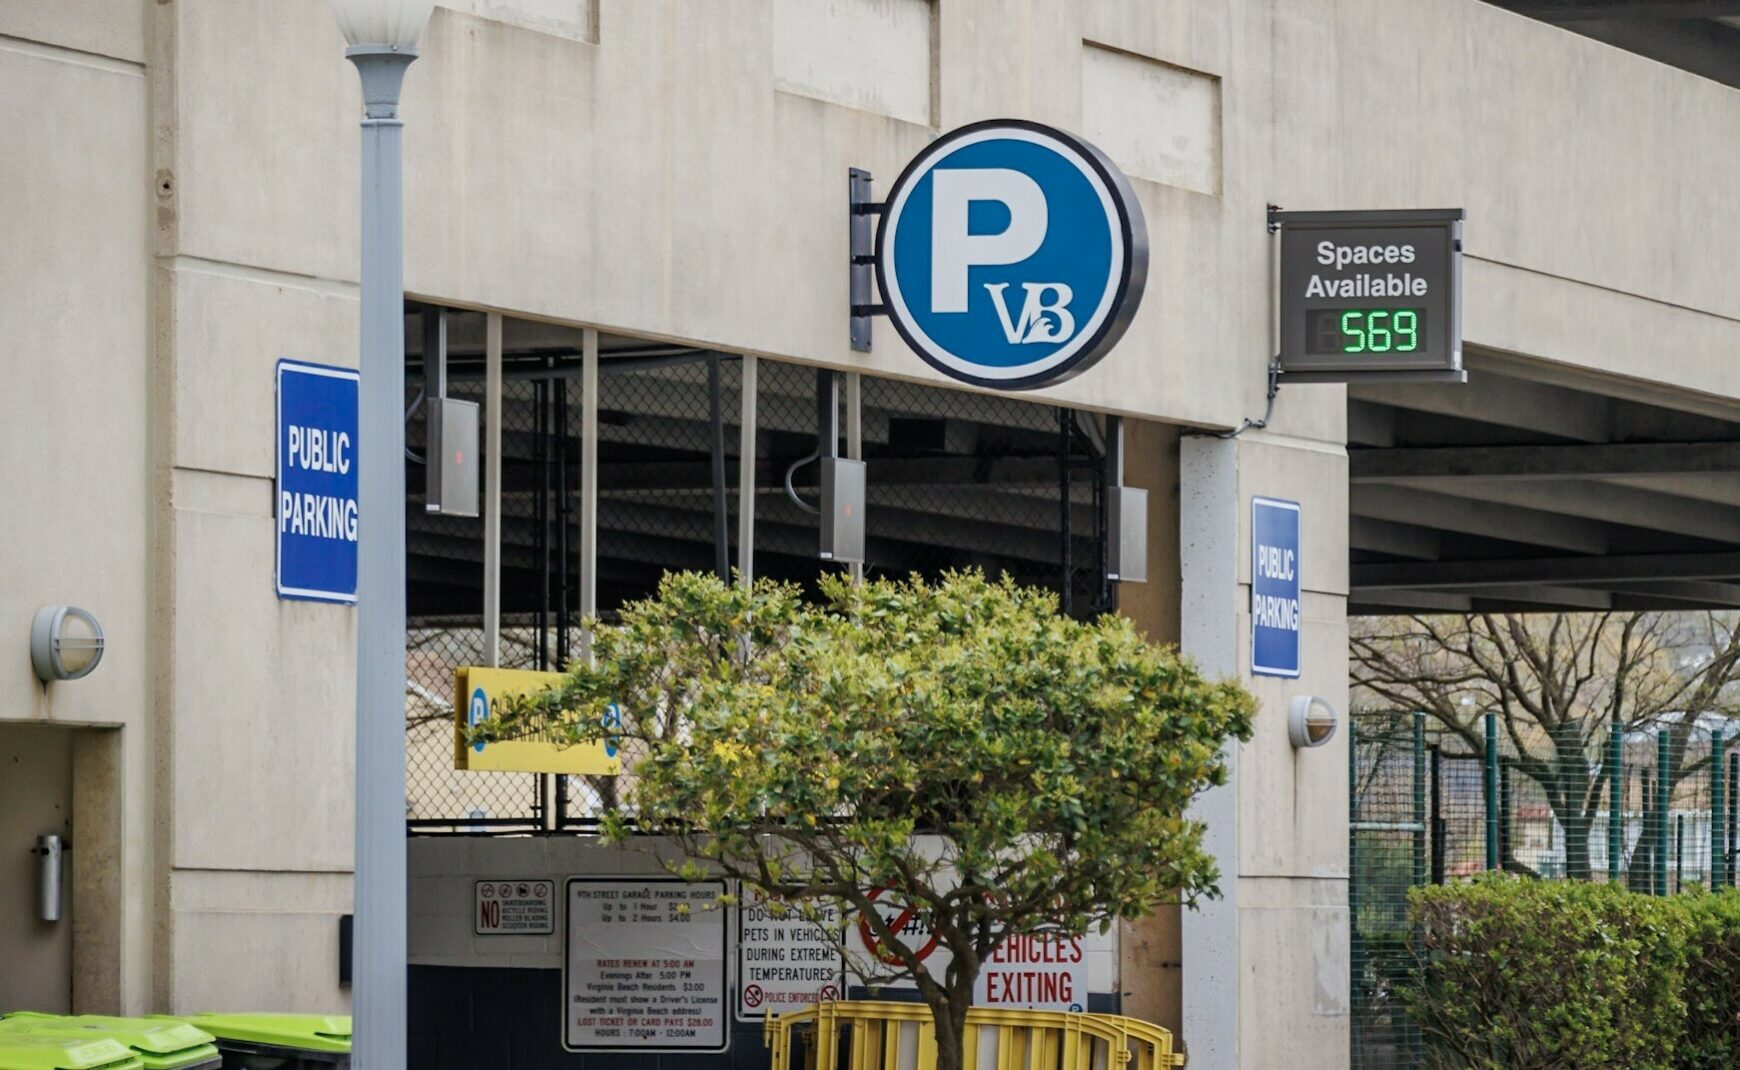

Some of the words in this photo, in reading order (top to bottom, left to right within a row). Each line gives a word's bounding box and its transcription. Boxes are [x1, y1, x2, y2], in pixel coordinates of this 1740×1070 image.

[931, 168, 1048, 313] P
[1317, 241, 1416, 270] Spaces
[1305, 273, 1428, 298] Available
[983, 282, 1076, 344] VB
[1341, 311, 1417, 352] 569
[288, 424, 351, 475] PUBLIC
[282, 490, 358, 542] PARKING
[1258, 544, 1294, 582] PUBLIC
[1255, 594, 1298, 631] PARKING
[577, 890, 592, 899] 9TH
[593, 890, 619, 900] STREET
[622, 890, 651, 900] GARAGE
[655, 890, 687, 900] PARKING
[690, 890, 716, 900] HOURS
[603, 903, 613, 912] Up
[619, 903, 627, 911] to
[640, 903, 658, 911] Hour
[481, 900, 500, 929] NO
[602, 915, 612, 924] Up
[641, 915, 662, 923] Hours
[668, 914, 691, 923] $4.00
[748, 908, 764, 921] DO
[744, 928, 769, 941] PETS
[774, 928, 785, 941] IN
[746, 948, 785, 961] DURING
[791, 948, 836, 961] EXTREME
[982, 933, 1082, 963] EHICLES
[597, 959, 620, 968] RATES
[623, 959, 648, 968] RENEW
[651, 960, 660, 968] AT
[663, 959, 681, 968] 5:00
[684, 959, 695, 968] AM
[600, 972, 633, 981] Evenings
[635, 971, 653, 980] After
[680, 971, 691, 979] PM
[749, 968, 834, 981] TEMPERATURES
[587, 983, 614, 993] Virginia
[617, 983, 639, 991] Beach
[642, 983, 676, 991] Residents
[683, 983, 705, 992] $3.00
[987, 972, 1072, 1003] EXITING
[609, 995, 629, 1003] must
[630, 995, 649, 1003] show
[660, 995, 689, 1003] Driver's
[691, 995, 718, 1004] License
[764, 992, 785, 1003] POLICE
[788, 992, 820, 1003] ENFORCED
[589, 1006, 605, 1015] with
[617, 1006, 644, 1017] Virginia
[647, 1006, 670, 1015] Beach
[672, 1006, 702, 1016] address)
[577, 1018, 596, 1027] LOST
[599, 1018, 624, 1027] TICKET
[627, 1018, 638, 1027] OR
[641, 1018, 661, 1027] CARD
[664, 1018, 684, 1027] PAYS
[595, 1029, 620, 1037] HOURS
[666, 1029, 696, 1037] 12:00AM
